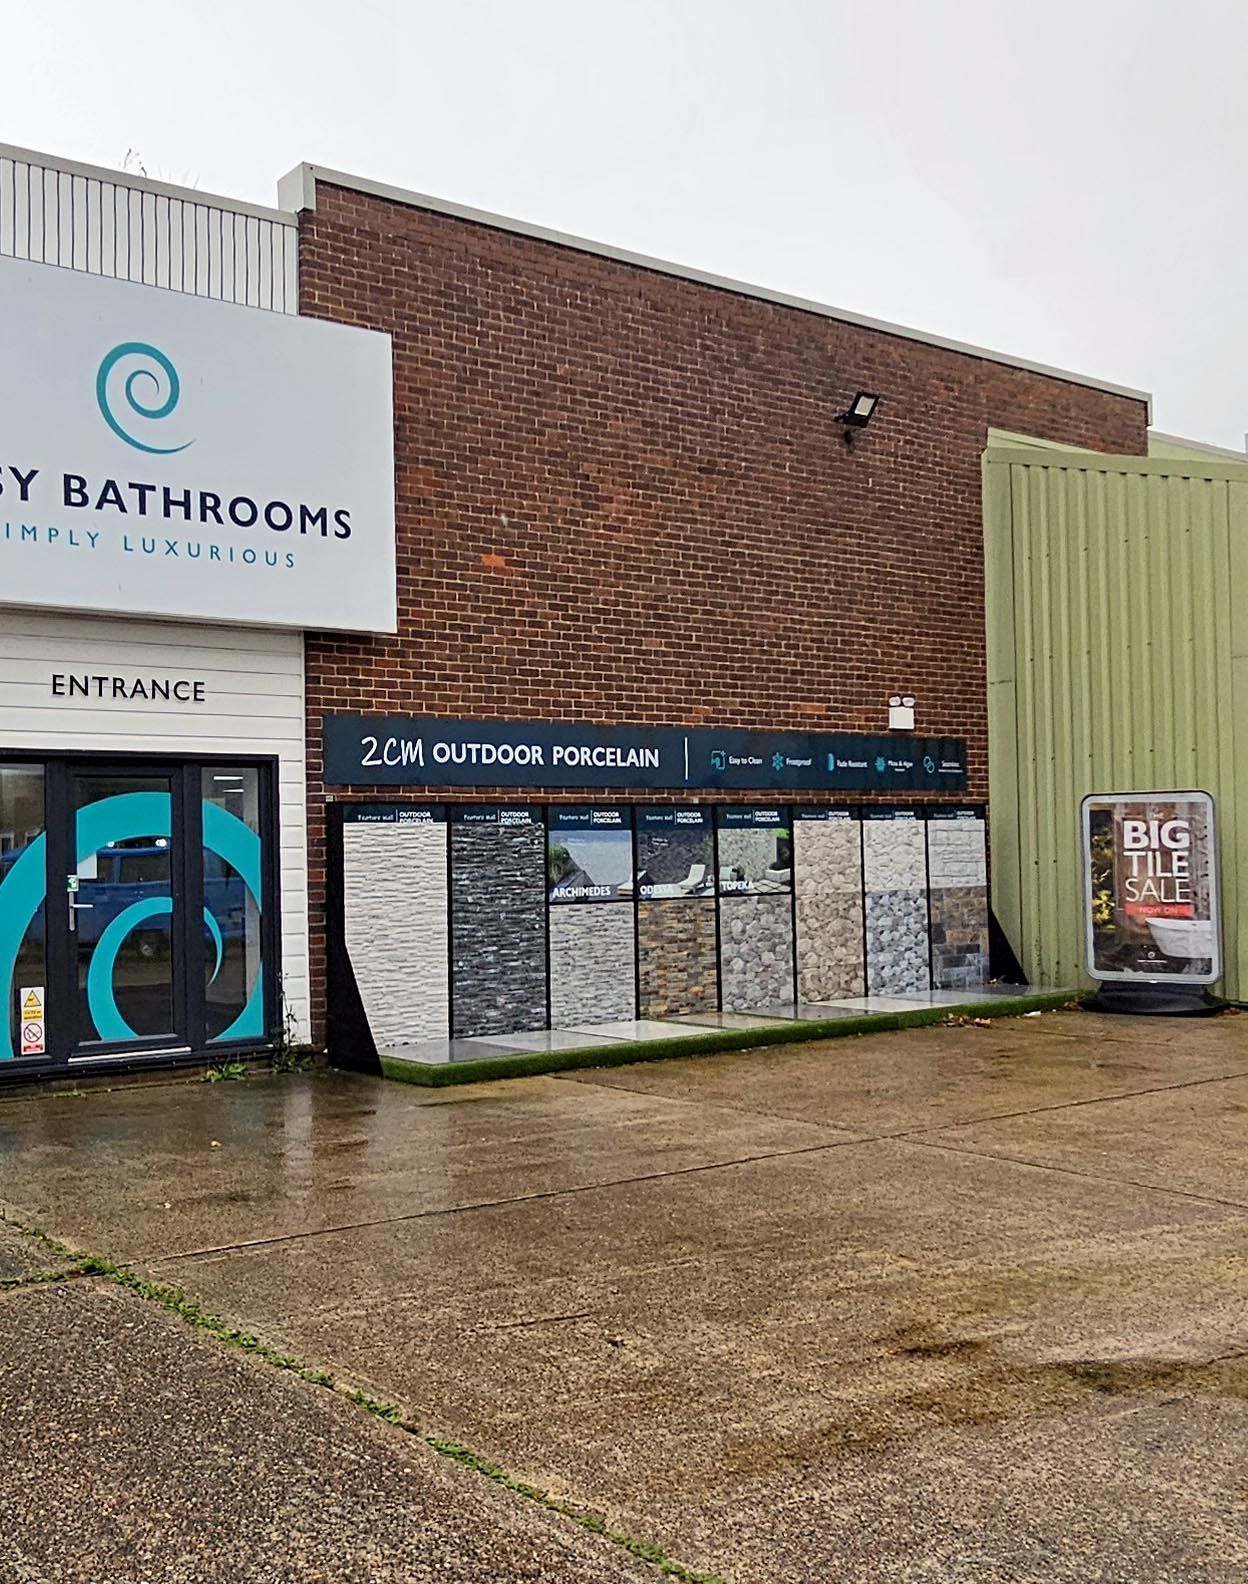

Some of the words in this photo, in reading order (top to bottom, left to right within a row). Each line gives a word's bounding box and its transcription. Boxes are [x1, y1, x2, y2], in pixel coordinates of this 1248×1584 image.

[62, 472, 353, 540] BATHROOMS
[123, 535, 296, 569] LUXURIOUS
[51, 673, 206, 703] ENTRANCE
[360, 736, 425, 768] 2CM
[432, 742, 545, 766] OUTDOOR
[552, 745, 660, 768] PORCELAIN
[1123, 820, 1190, 849] BIG
[1123, 851, 1190, 877] TILE
[552, 886, 611, 898] ARCHIMEDES
[722, 880, 753, 891] TOPEKA
[1125, 878, 1192, 903] SALE
[1139, 906, 1161, 914] NOW
[1163, 906, 1178, 914] ON
